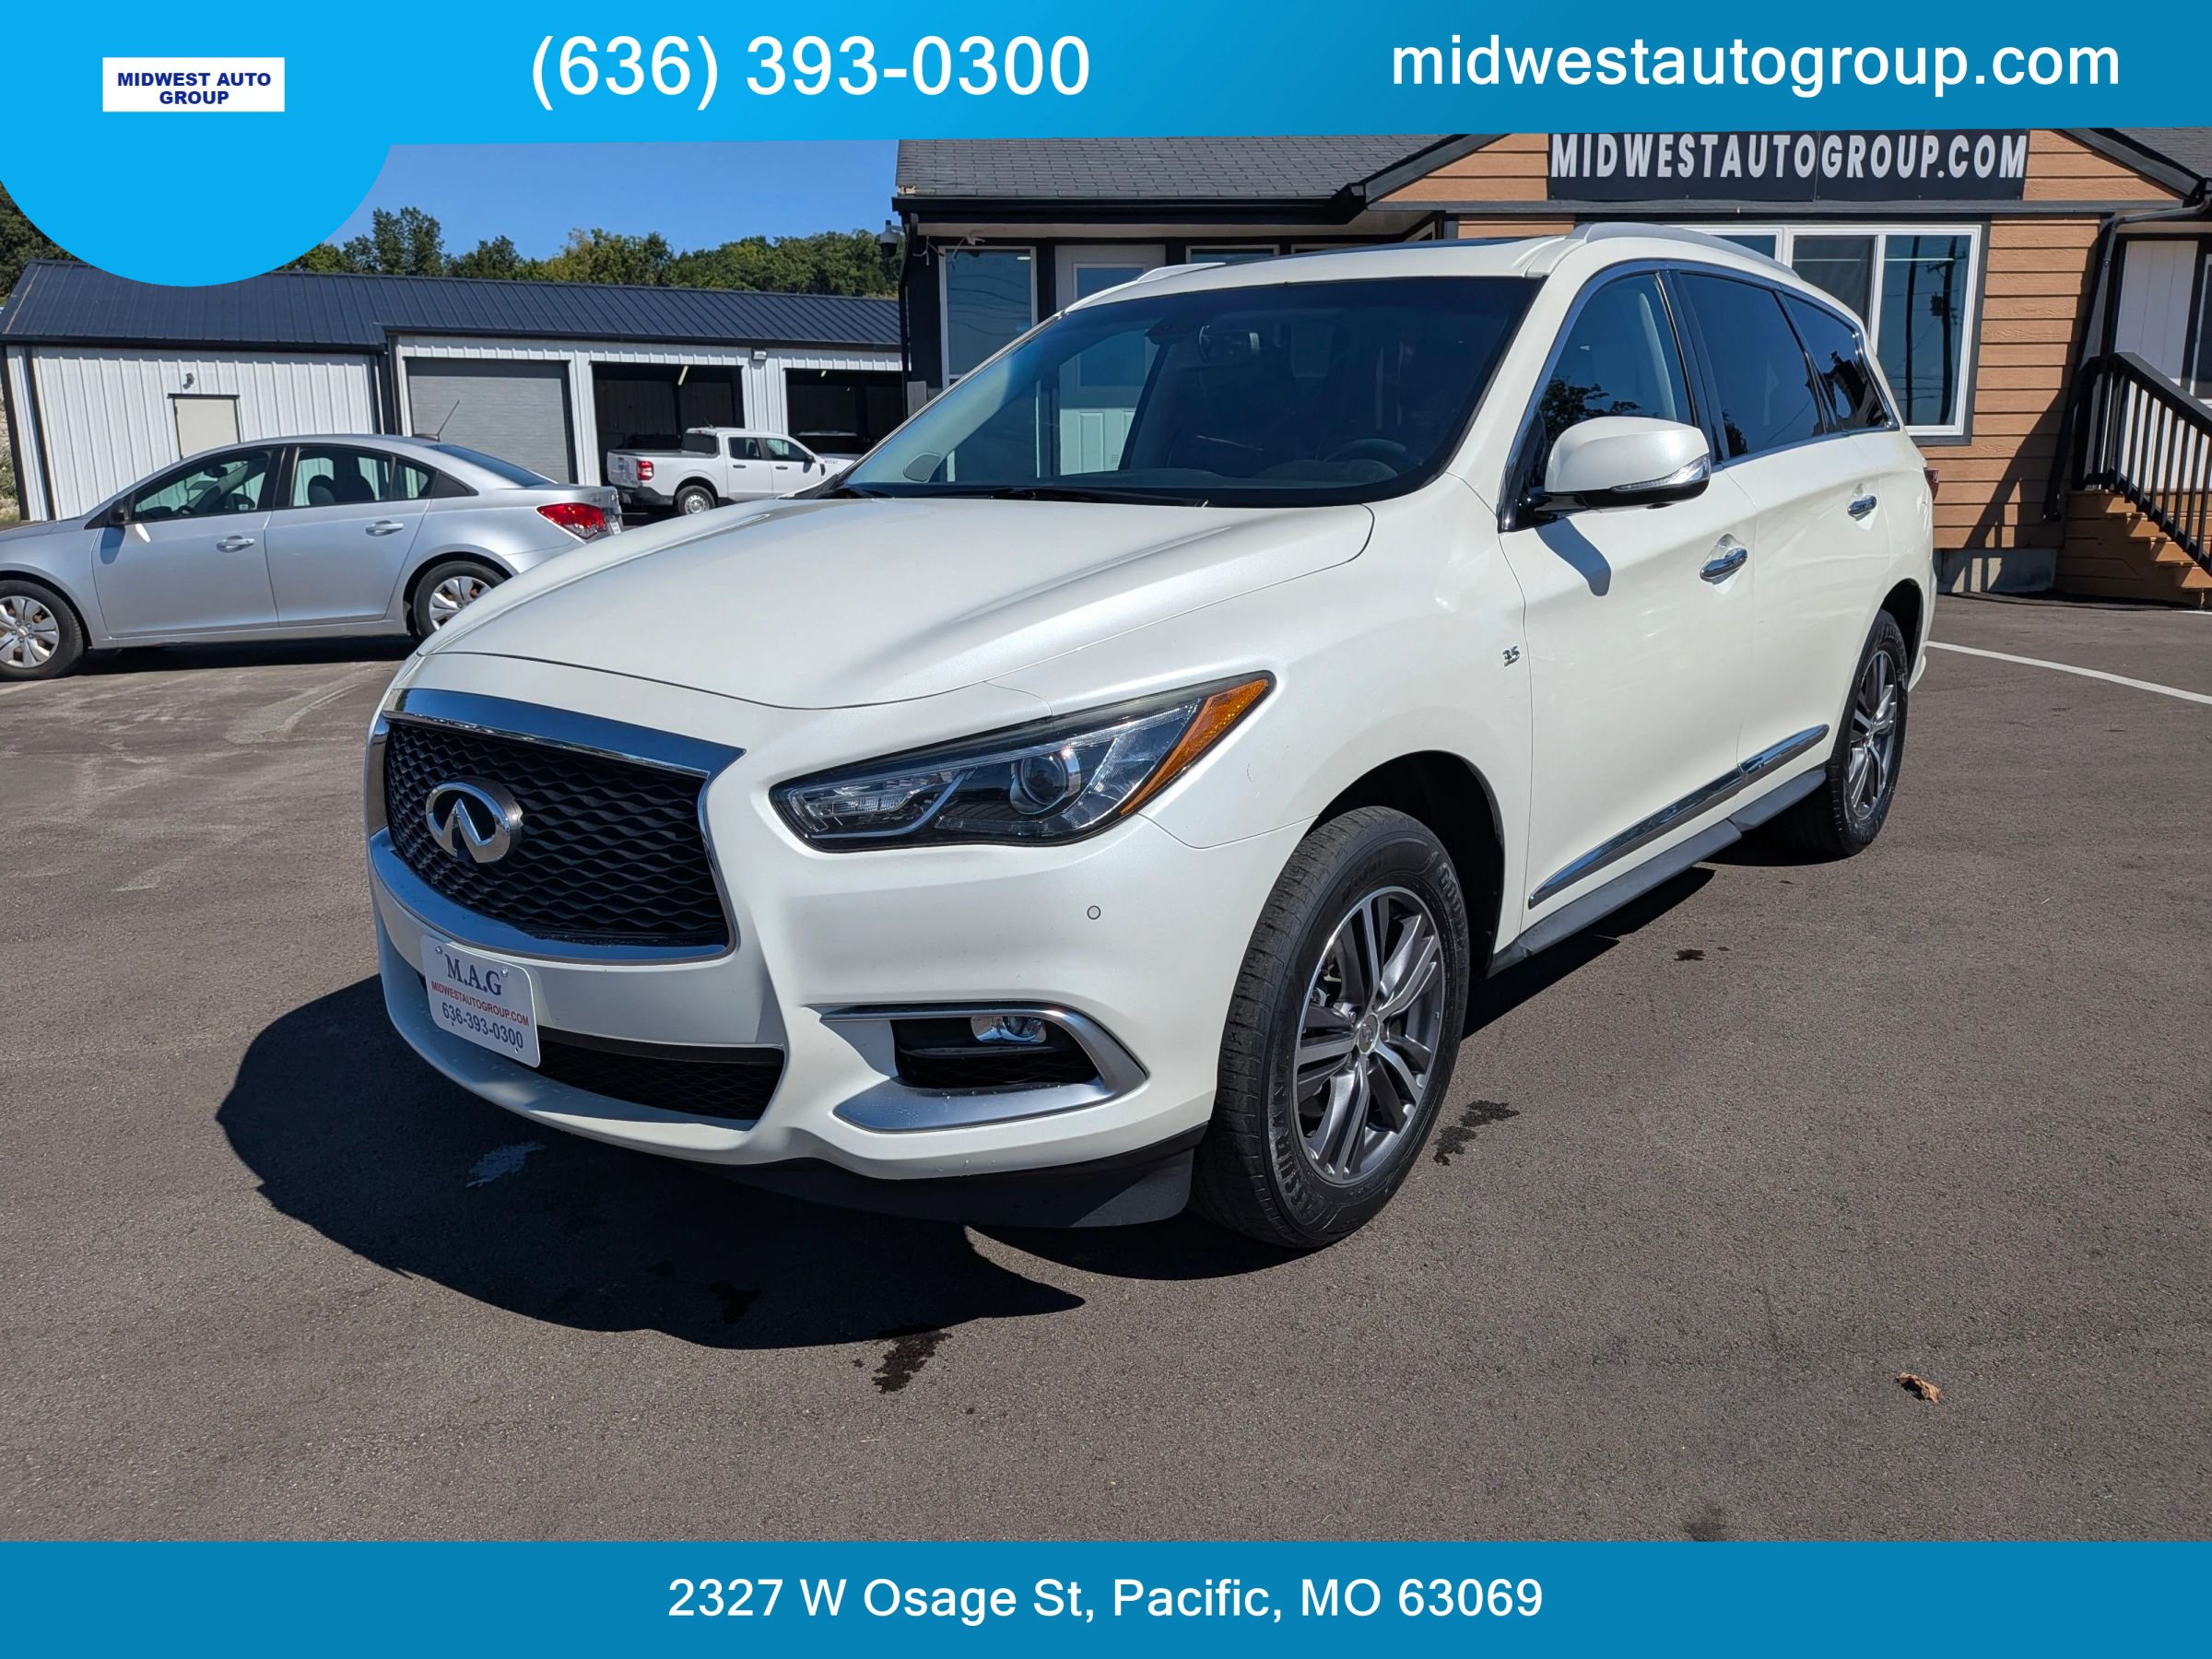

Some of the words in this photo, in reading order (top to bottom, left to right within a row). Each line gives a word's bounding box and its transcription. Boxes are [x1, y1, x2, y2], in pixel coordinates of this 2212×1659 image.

[1551, 134, 2027, 179] MIDWESTAUTOGROUP.COM
[430, 981, 530, 1027] MIDWESTAUTOGROUP.COM
[441, 1002, 524, 1049] 636-393-0300
